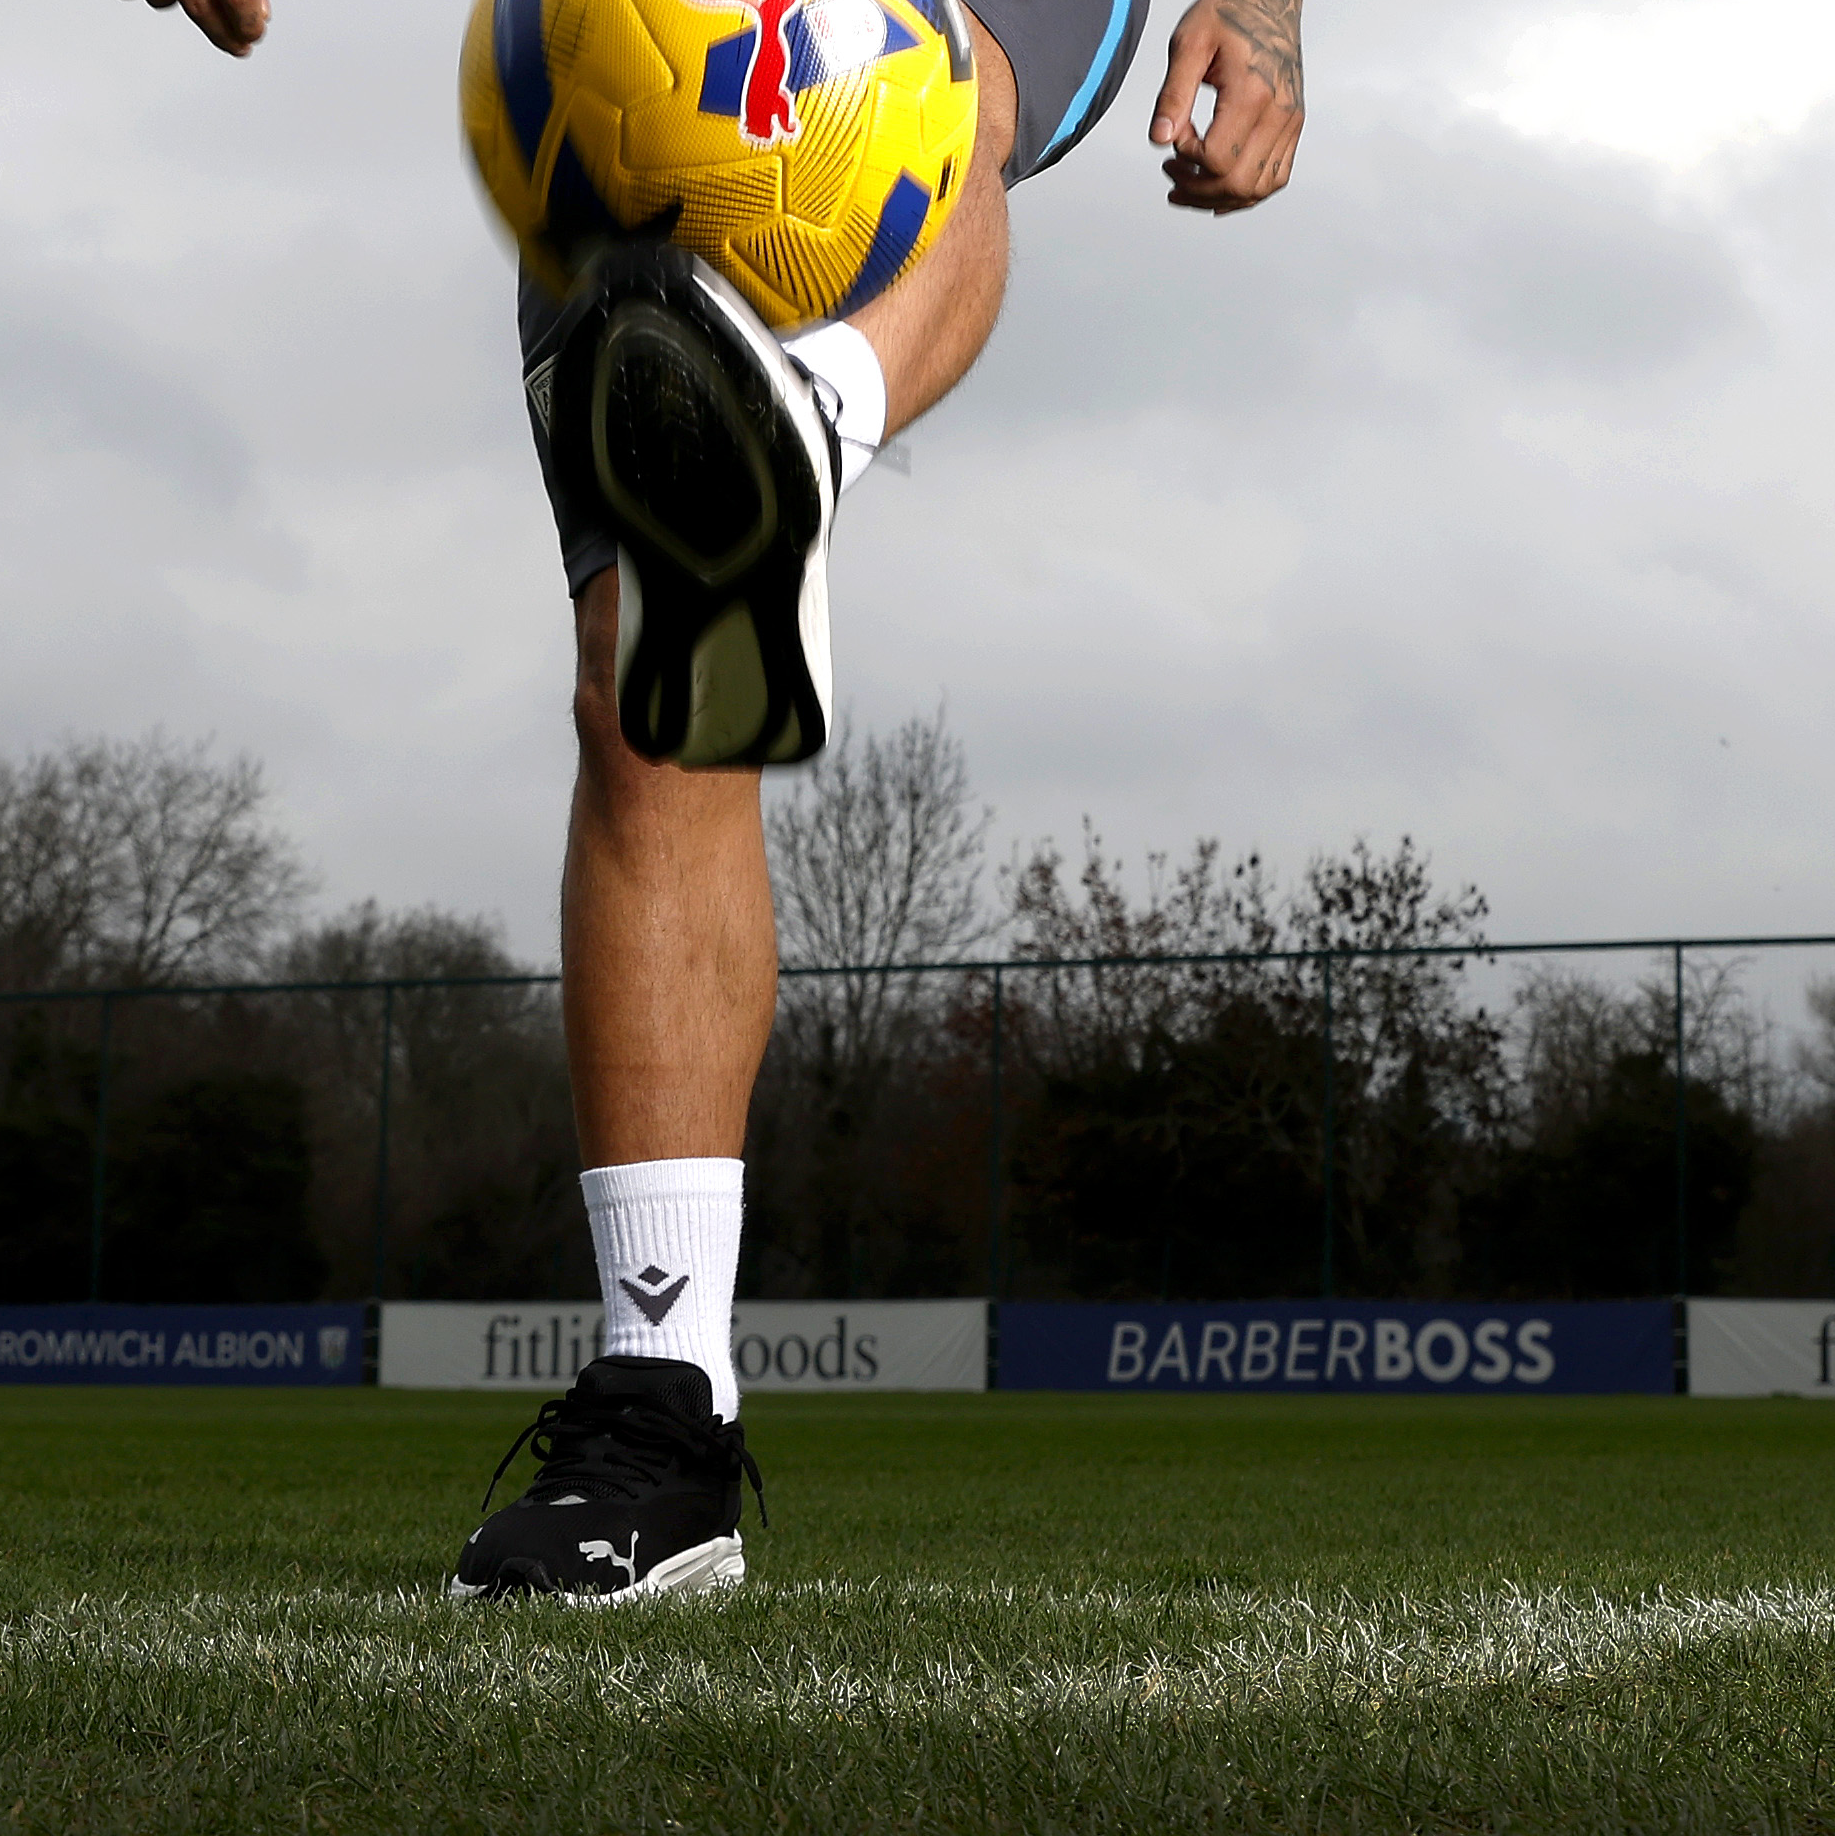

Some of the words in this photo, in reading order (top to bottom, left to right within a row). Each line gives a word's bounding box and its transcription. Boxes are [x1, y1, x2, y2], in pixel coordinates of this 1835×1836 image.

[173, 1331, 304, 1368] ALBION
[482, 1314, 606, 1380] fitlif
[731, 1315, 879, 1382] oods
[1107, 1318, 1555, 1384] BARBERBOSS
